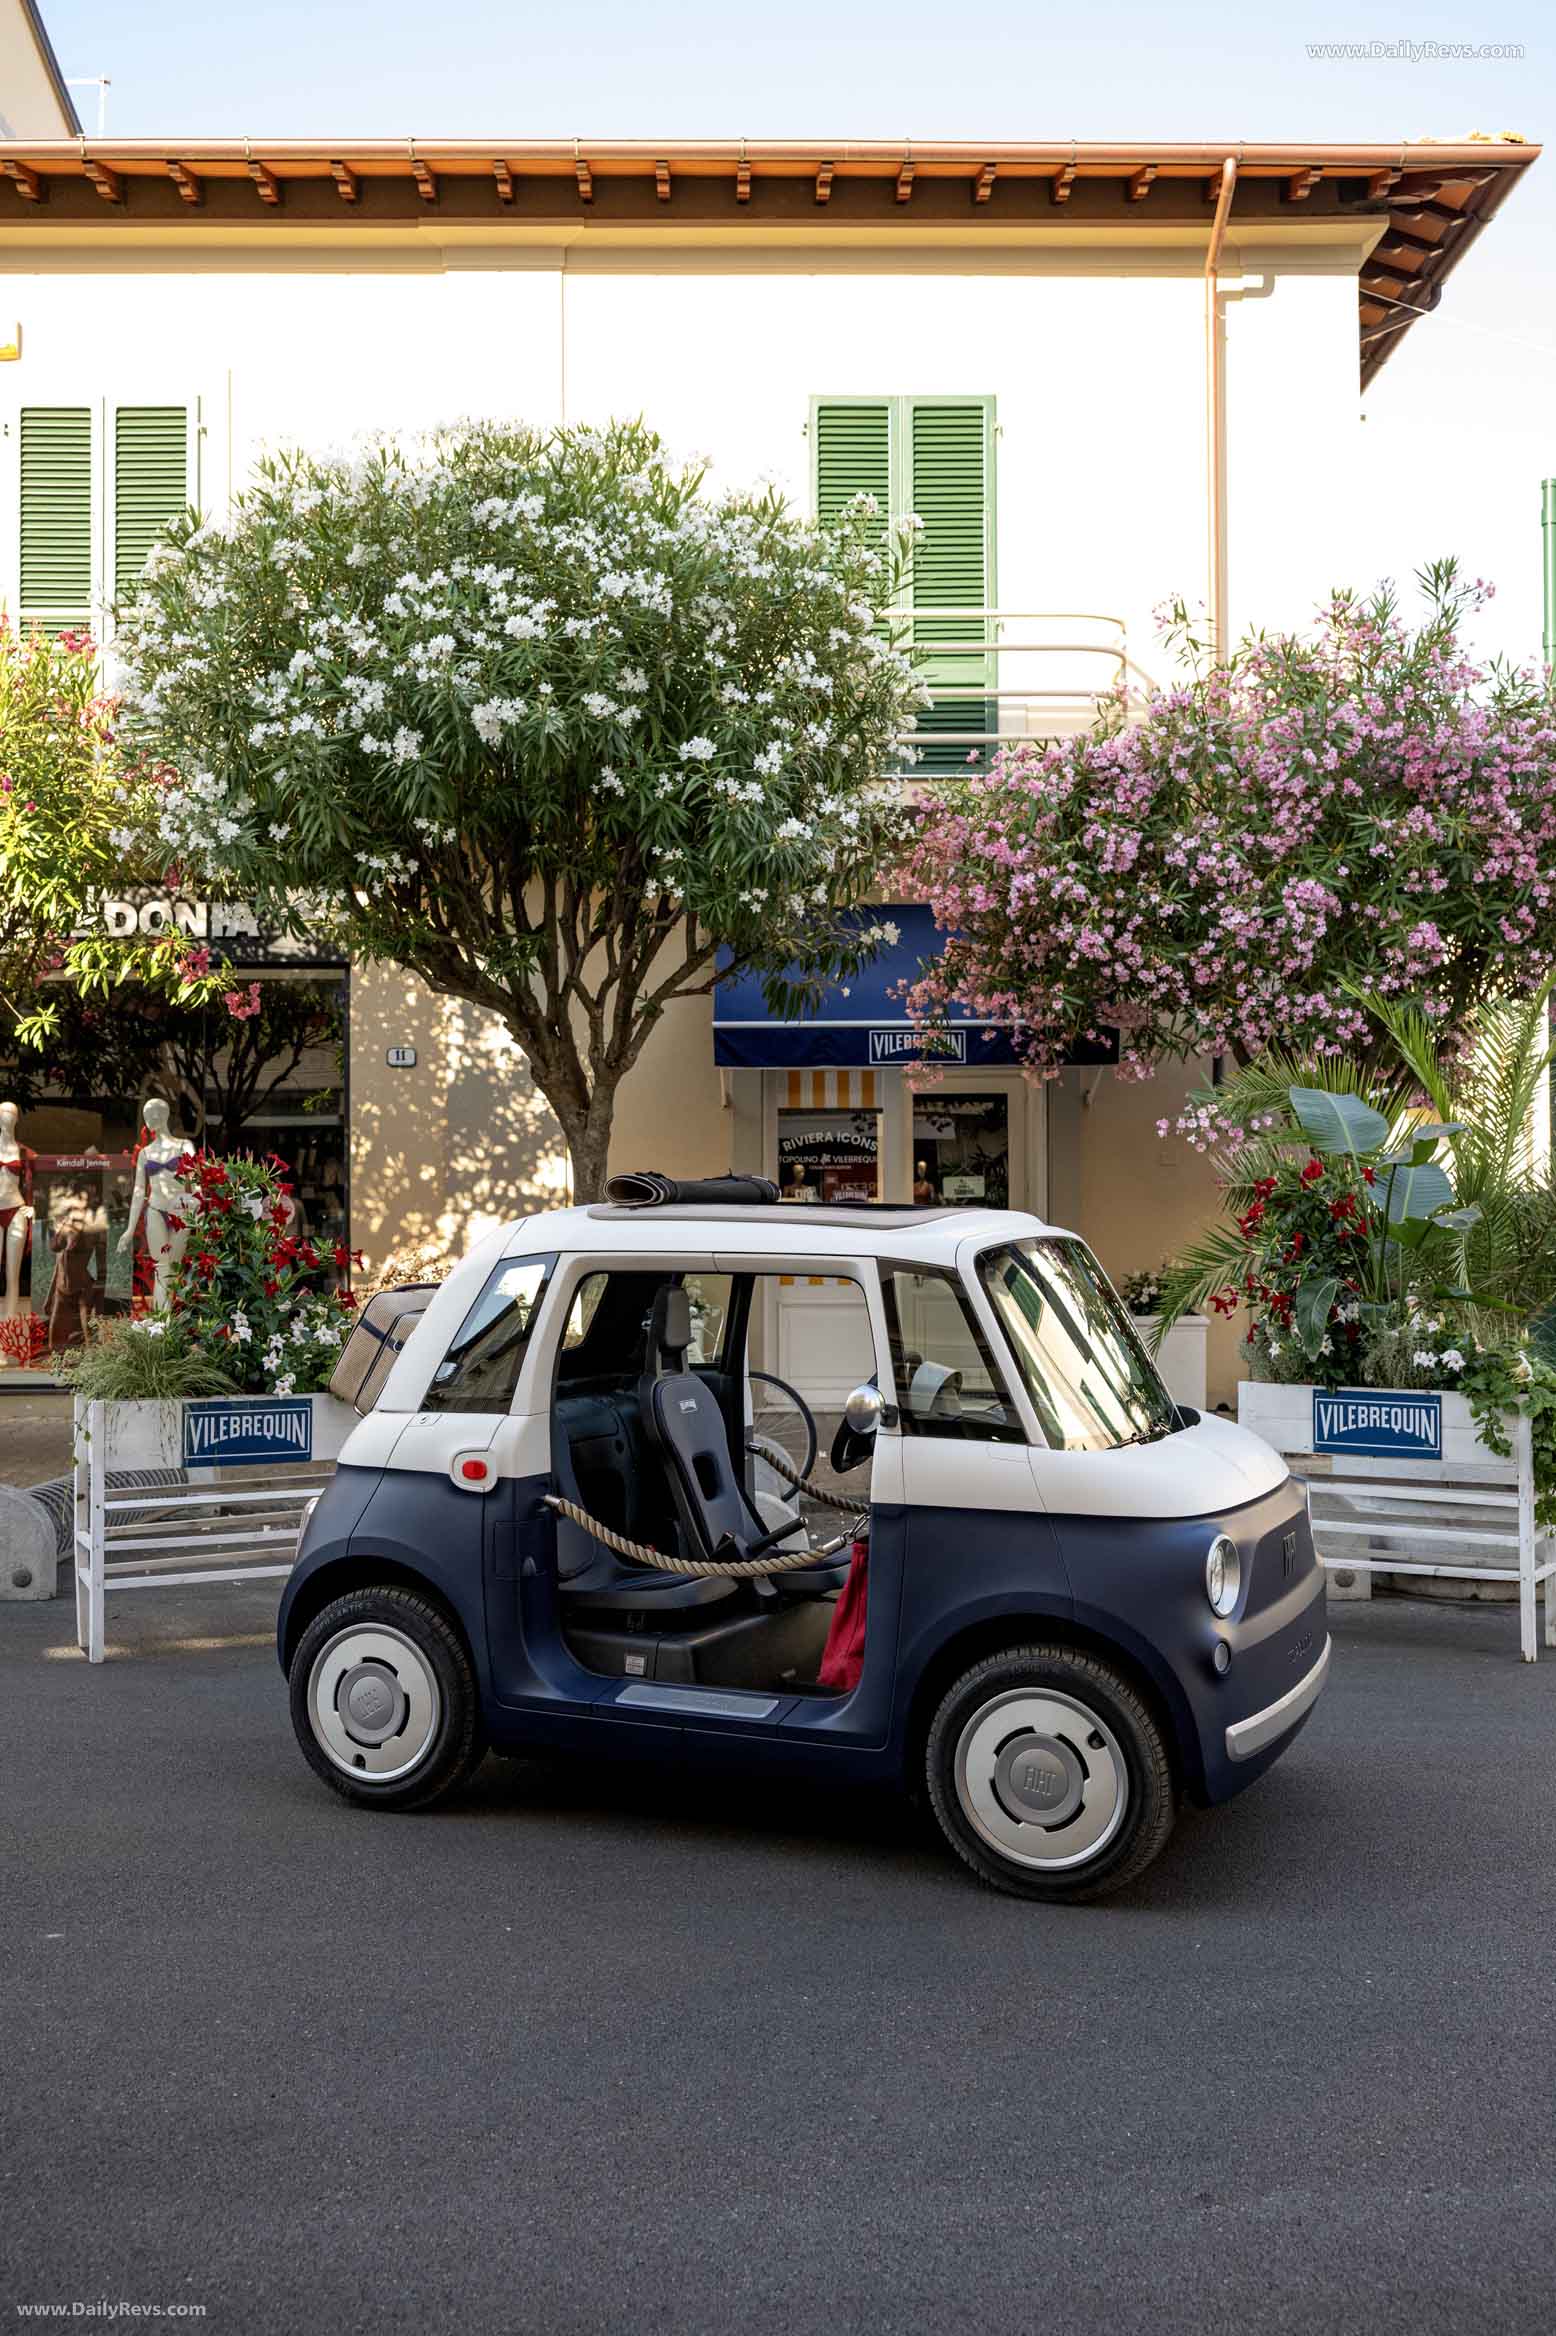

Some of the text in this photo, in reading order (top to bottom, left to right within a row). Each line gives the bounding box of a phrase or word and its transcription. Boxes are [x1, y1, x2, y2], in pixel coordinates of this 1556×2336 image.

[782, 1132, 878, 1152] RIVIERA ICONS
[57, 1158, 84, 1168] Kendall
[190, 1412, 306, 1454] VILEBREQUIN
[1320, 1404, 1435, 1446] VILEBREQUIN
